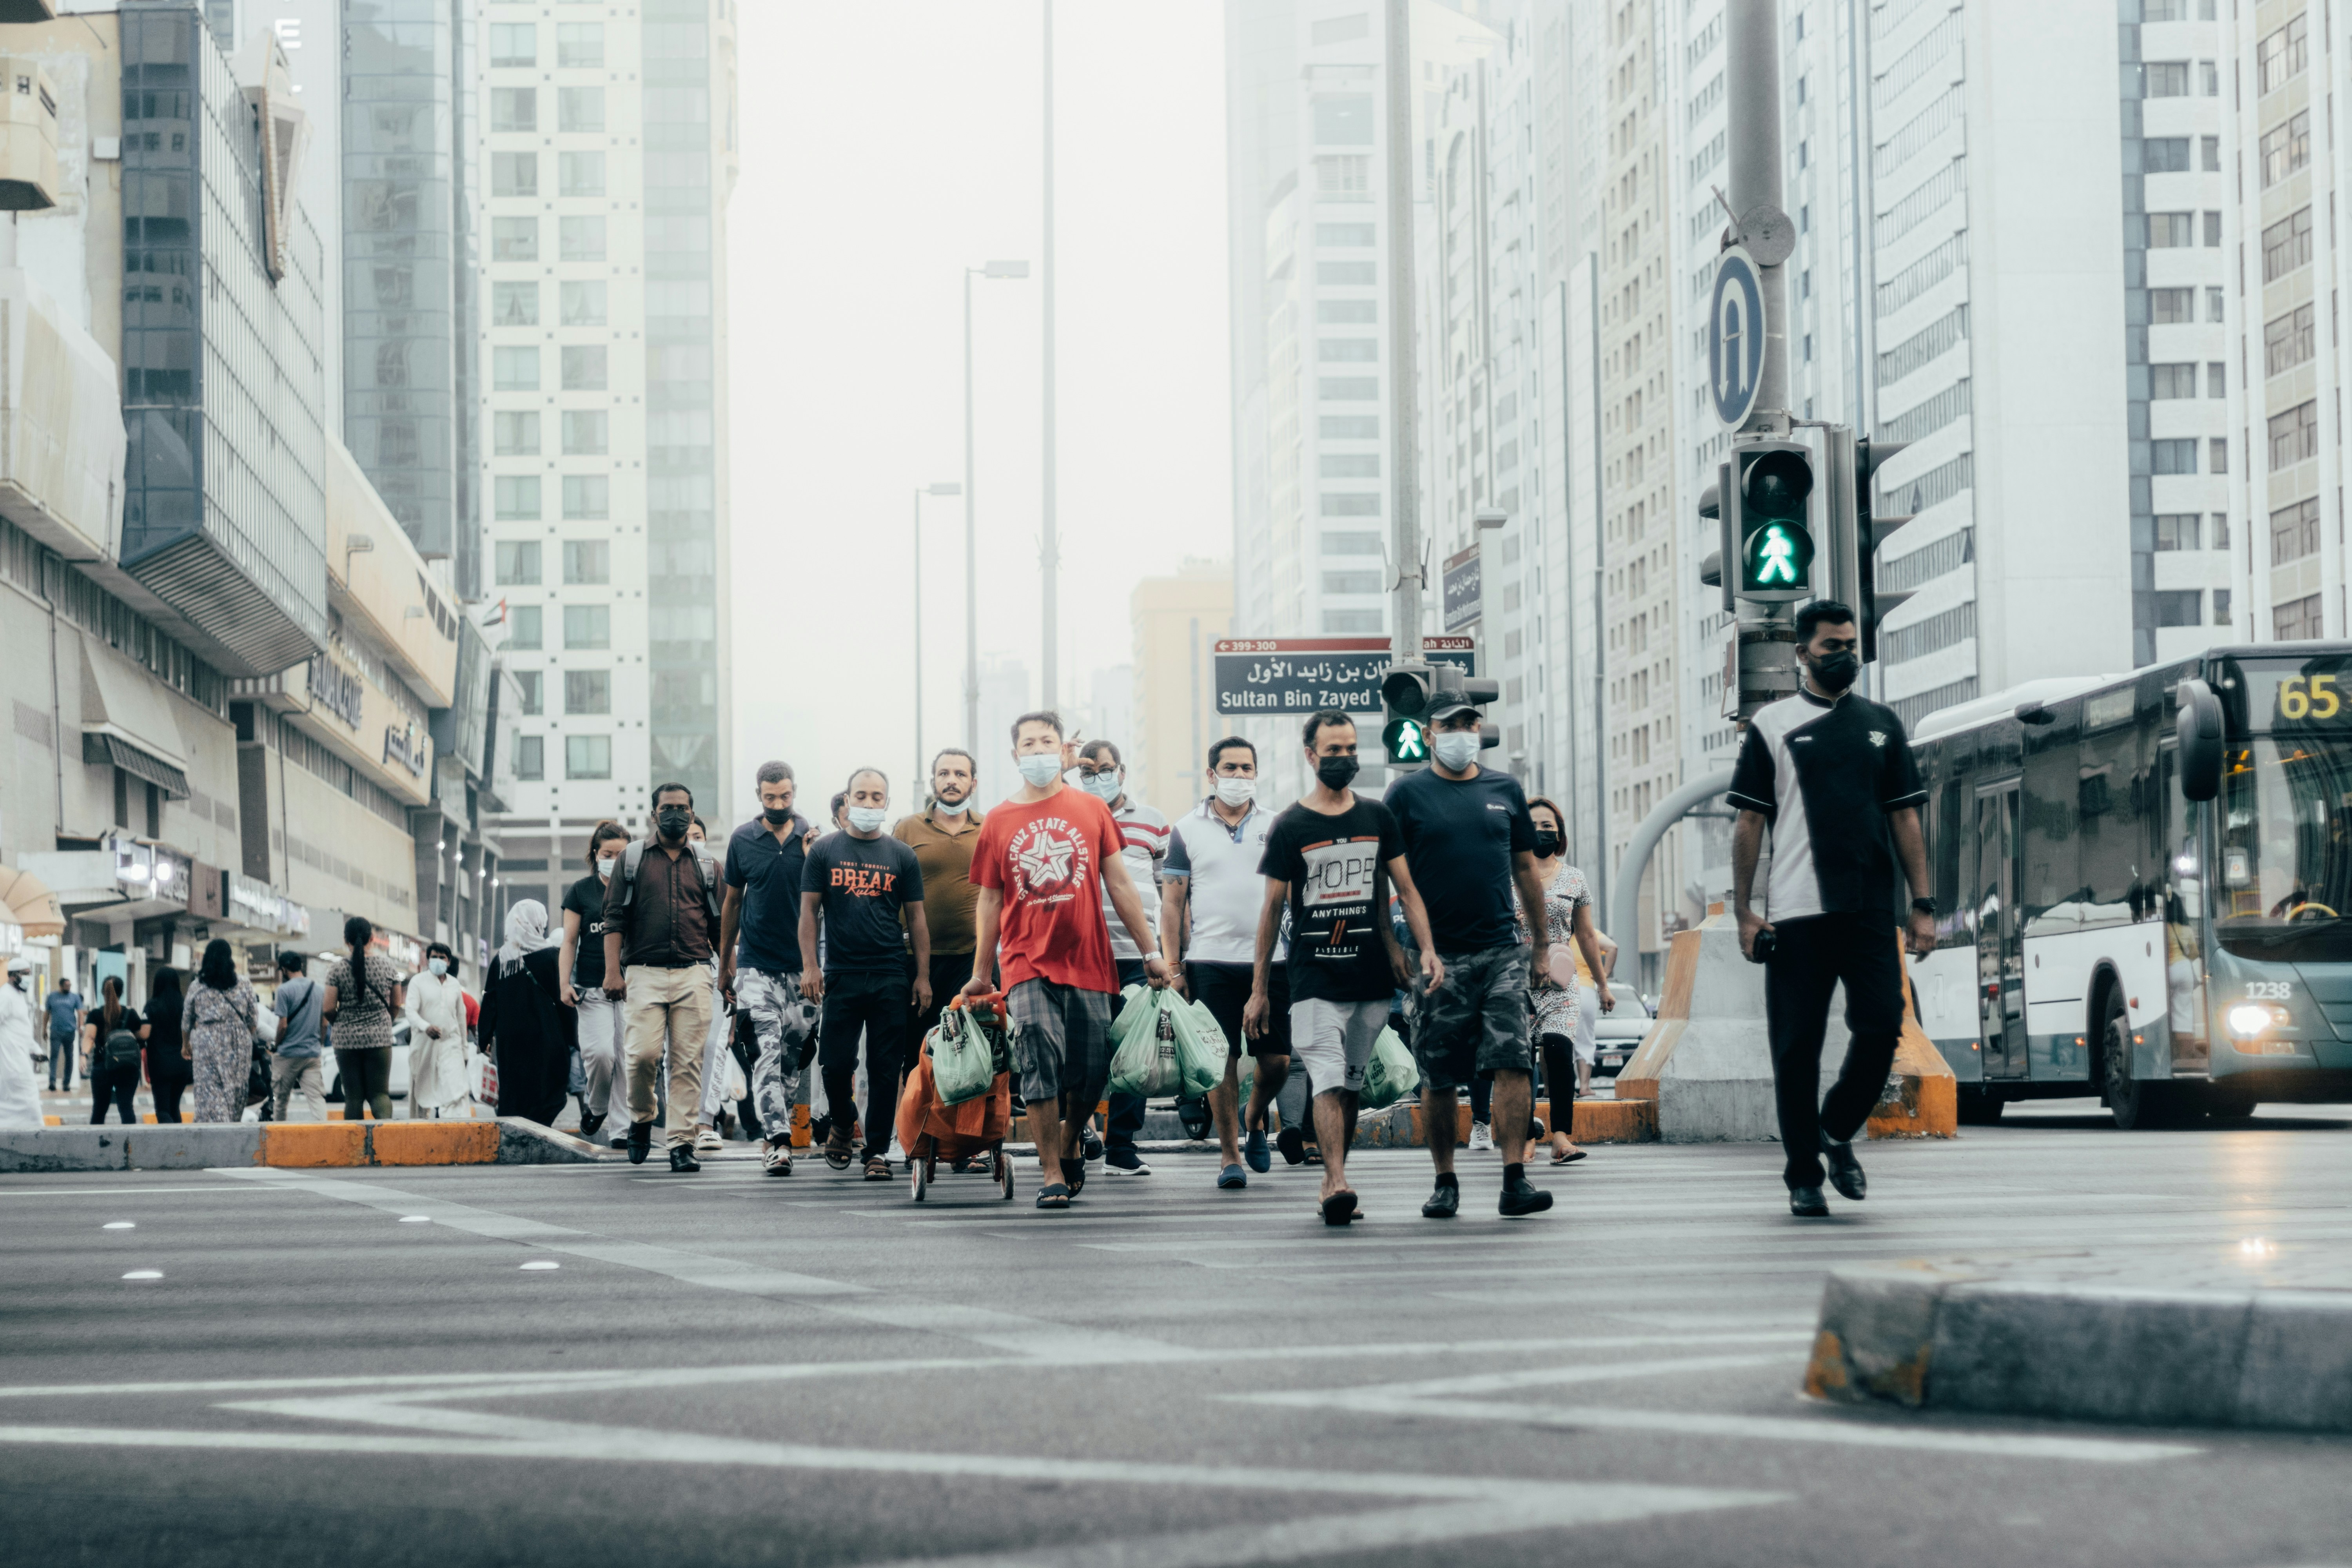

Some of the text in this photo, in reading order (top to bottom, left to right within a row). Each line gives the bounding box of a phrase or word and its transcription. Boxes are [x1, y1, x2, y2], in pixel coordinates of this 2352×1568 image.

[1232, 641, 1277, 651] 399-300
[1247, 657, 1292, 684] الأول
[1297, 662, 1333, 682] زايد
[1337, 663, 1360, 684] بن
[1221, 691, 1277, 707] Sultan
[1285, 689, 1312, 706] Bin
[1319, 689, 1370, 709] Zayed
[2280, 675, 2339, 719] 65
[1009, 828, 1029, 861] CRUZ
[1029, 817, 1068, 833] STATE
[831, 868, 897, 892] BREAK
[1306, 857, 1374, 891] HOPE
[1312, 906, 1367, 918] ANYTHING'S
[2246, 982, 2291, 1000] 1238
